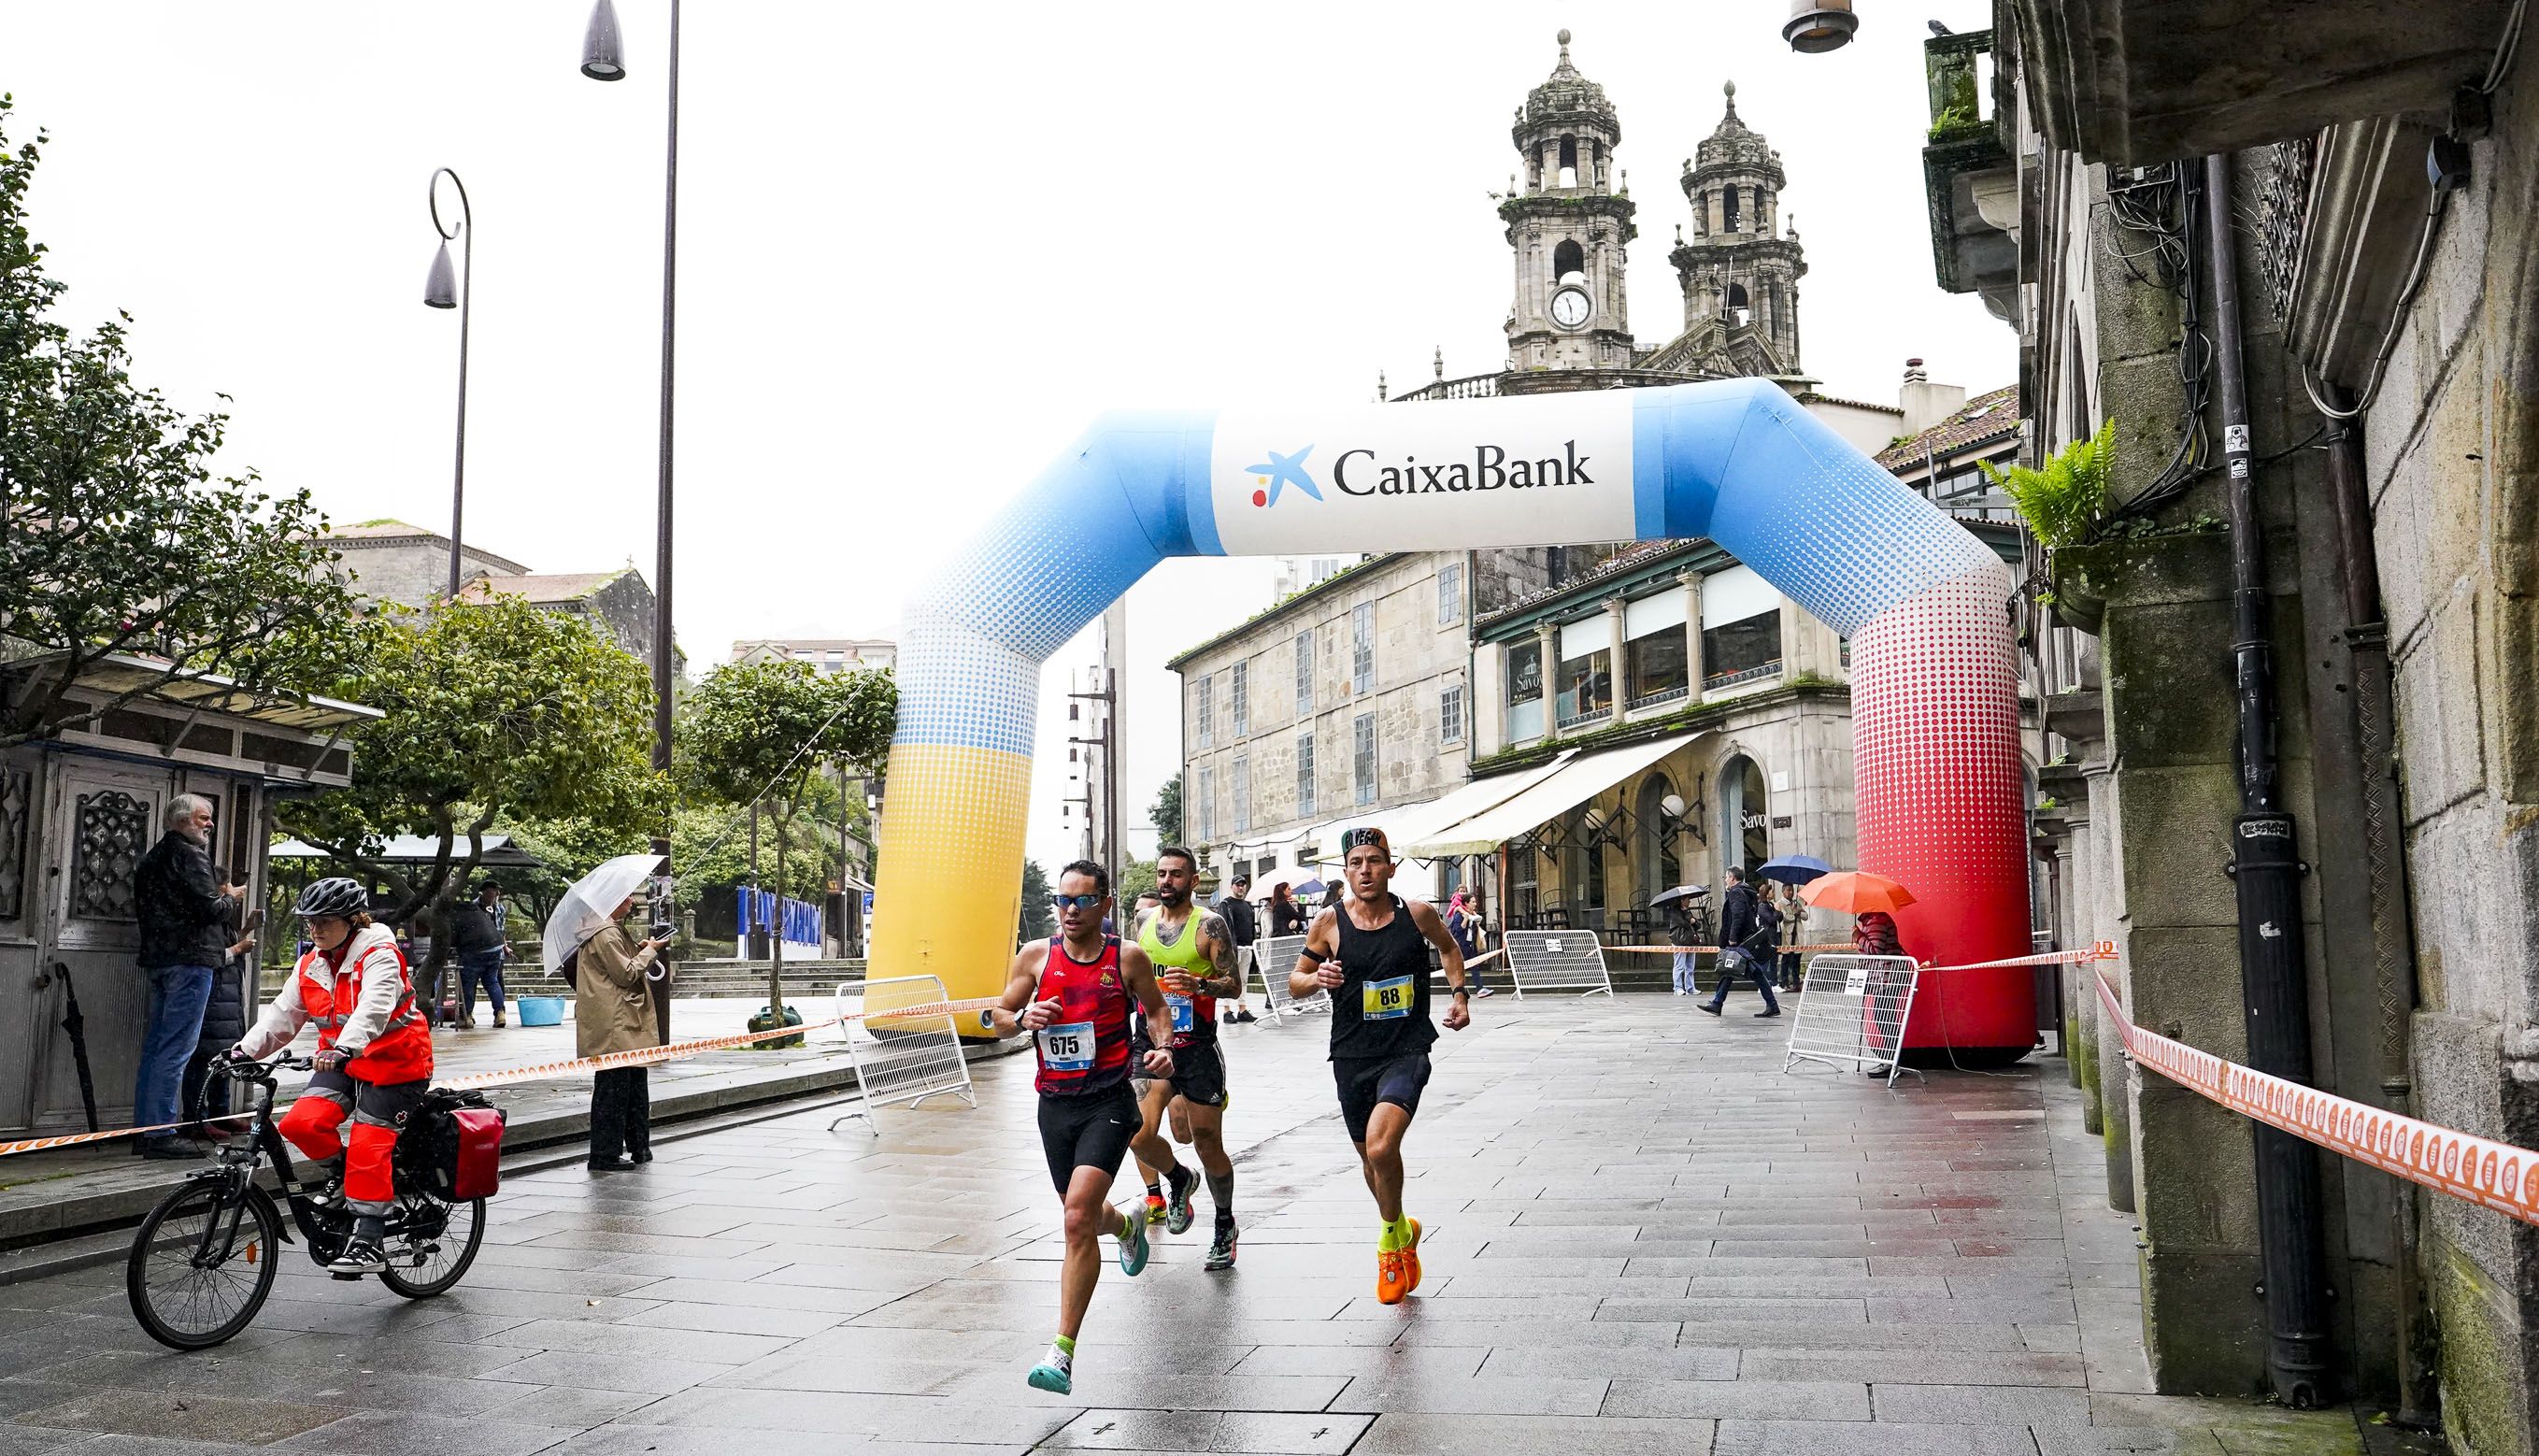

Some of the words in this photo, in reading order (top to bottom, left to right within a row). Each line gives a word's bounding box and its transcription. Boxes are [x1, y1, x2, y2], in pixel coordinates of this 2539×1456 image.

[1334, 439, 1594, 497] CaixaBank
[1740, 810, 1767, 829] Savo
[1346, 832, 1353, 849] GO
[1356, 830, 1381, 845] VEGAN
[1380, 988, 1400, 1006] 88
[1049, 1035, 1079, 1055] 675
